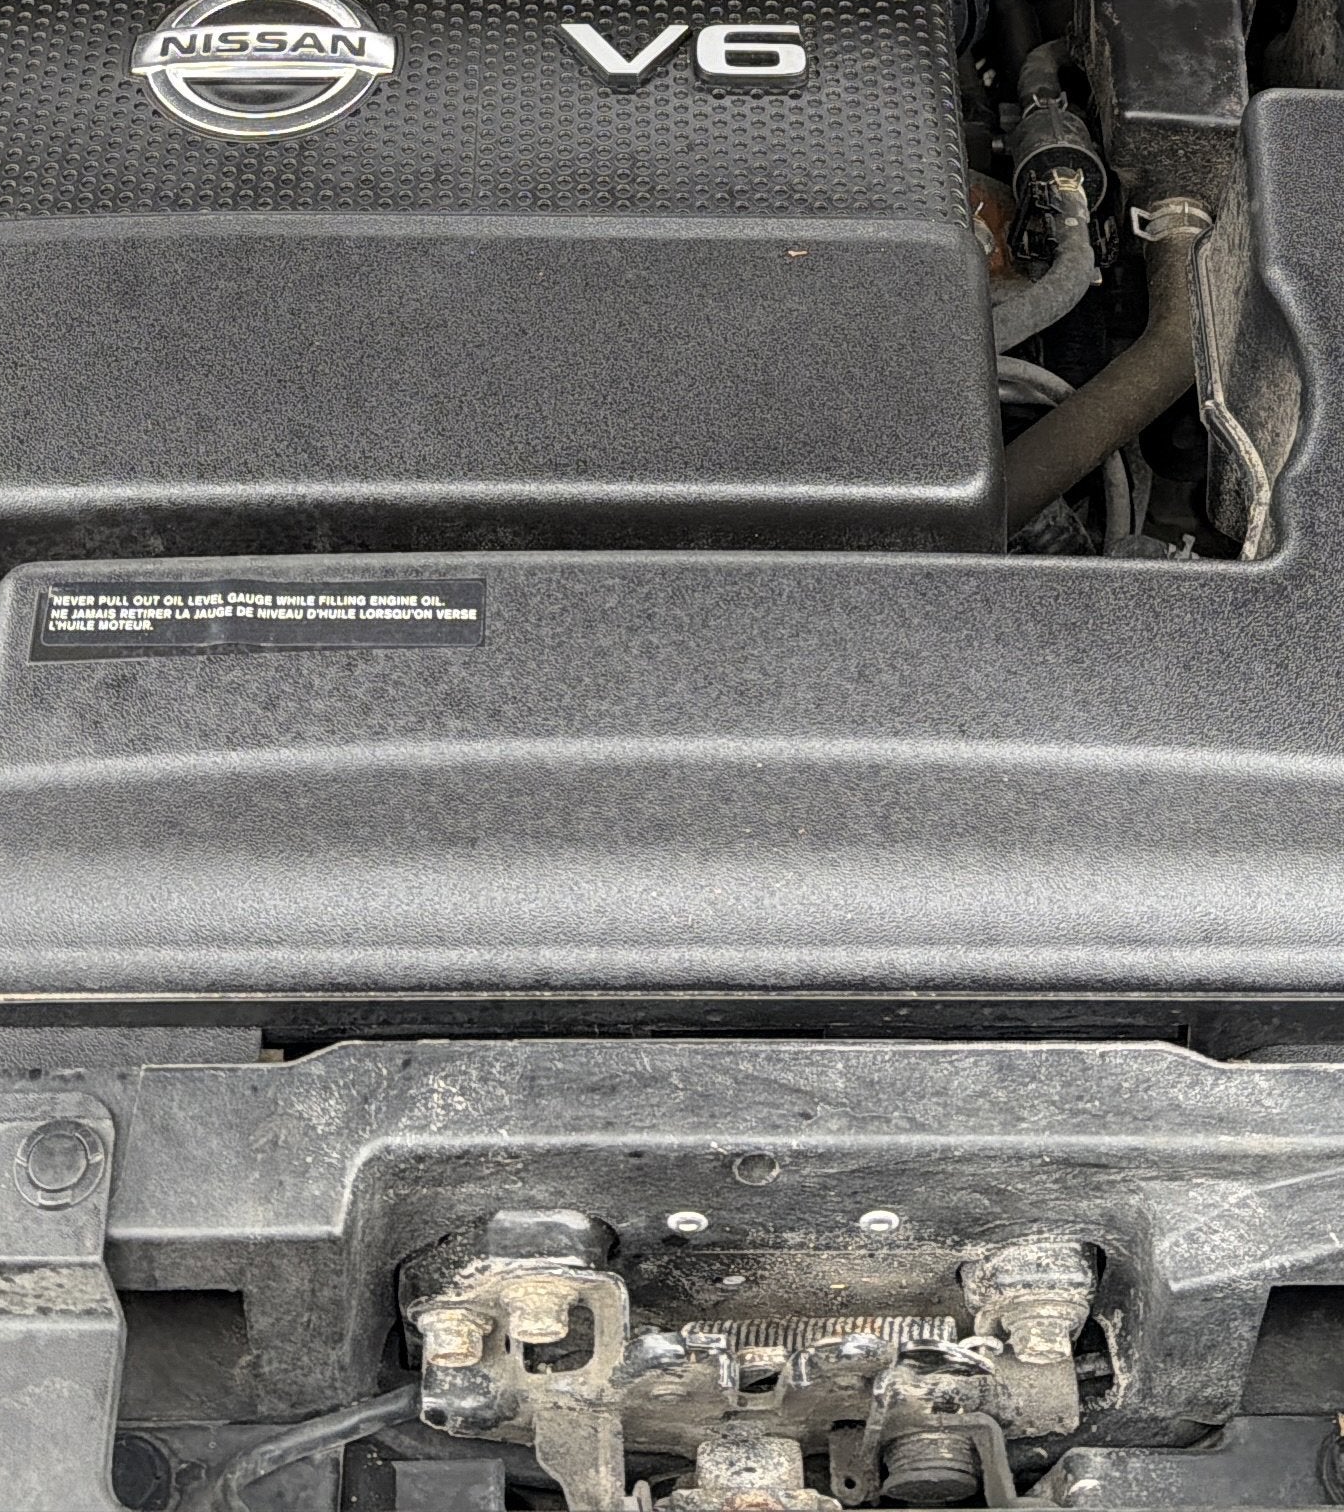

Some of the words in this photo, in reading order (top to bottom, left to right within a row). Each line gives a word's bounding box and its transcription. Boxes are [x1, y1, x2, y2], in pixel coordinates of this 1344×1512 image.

[160, 29, 366, 57] NISSAN
[562, 24, 807, 80] V6
[53, 594, 95, 607] NEVER
[98, 594, 129, 607] PULL
[133, 594, 160, 607] OUT
[163, 594, 184, 607] OIL
[188, 593, 224, 606] LEVEL
[227, 593, 273, 606] GAUGE
[276, 595, 316, 607] WHILE
[319, 595, 367, 607] FILLING
[370, 595, 418, 607] ENGINE
[421, 595, 446, 607] OIL.
[51, 608, 68, 620] NE
[71, 608, 117, 620] JAMAIS
[120, 608, 172, 620] RETIRER
[175, 608, 191, 620] LA
[194, 607, 234, 620] JAUGE
[236, 606, 254, 619] DE
[257, 608, 304, 620] NIVEAU
[307, 608, 357, 620] D'HUILE
[360, 608, 433, 620] LORSQU'ON
[436, 608, 478, 620] VERSE
[49, 620, 95, 631] L'HUILE
[98, 620, 154, 631] MOTEUR.
